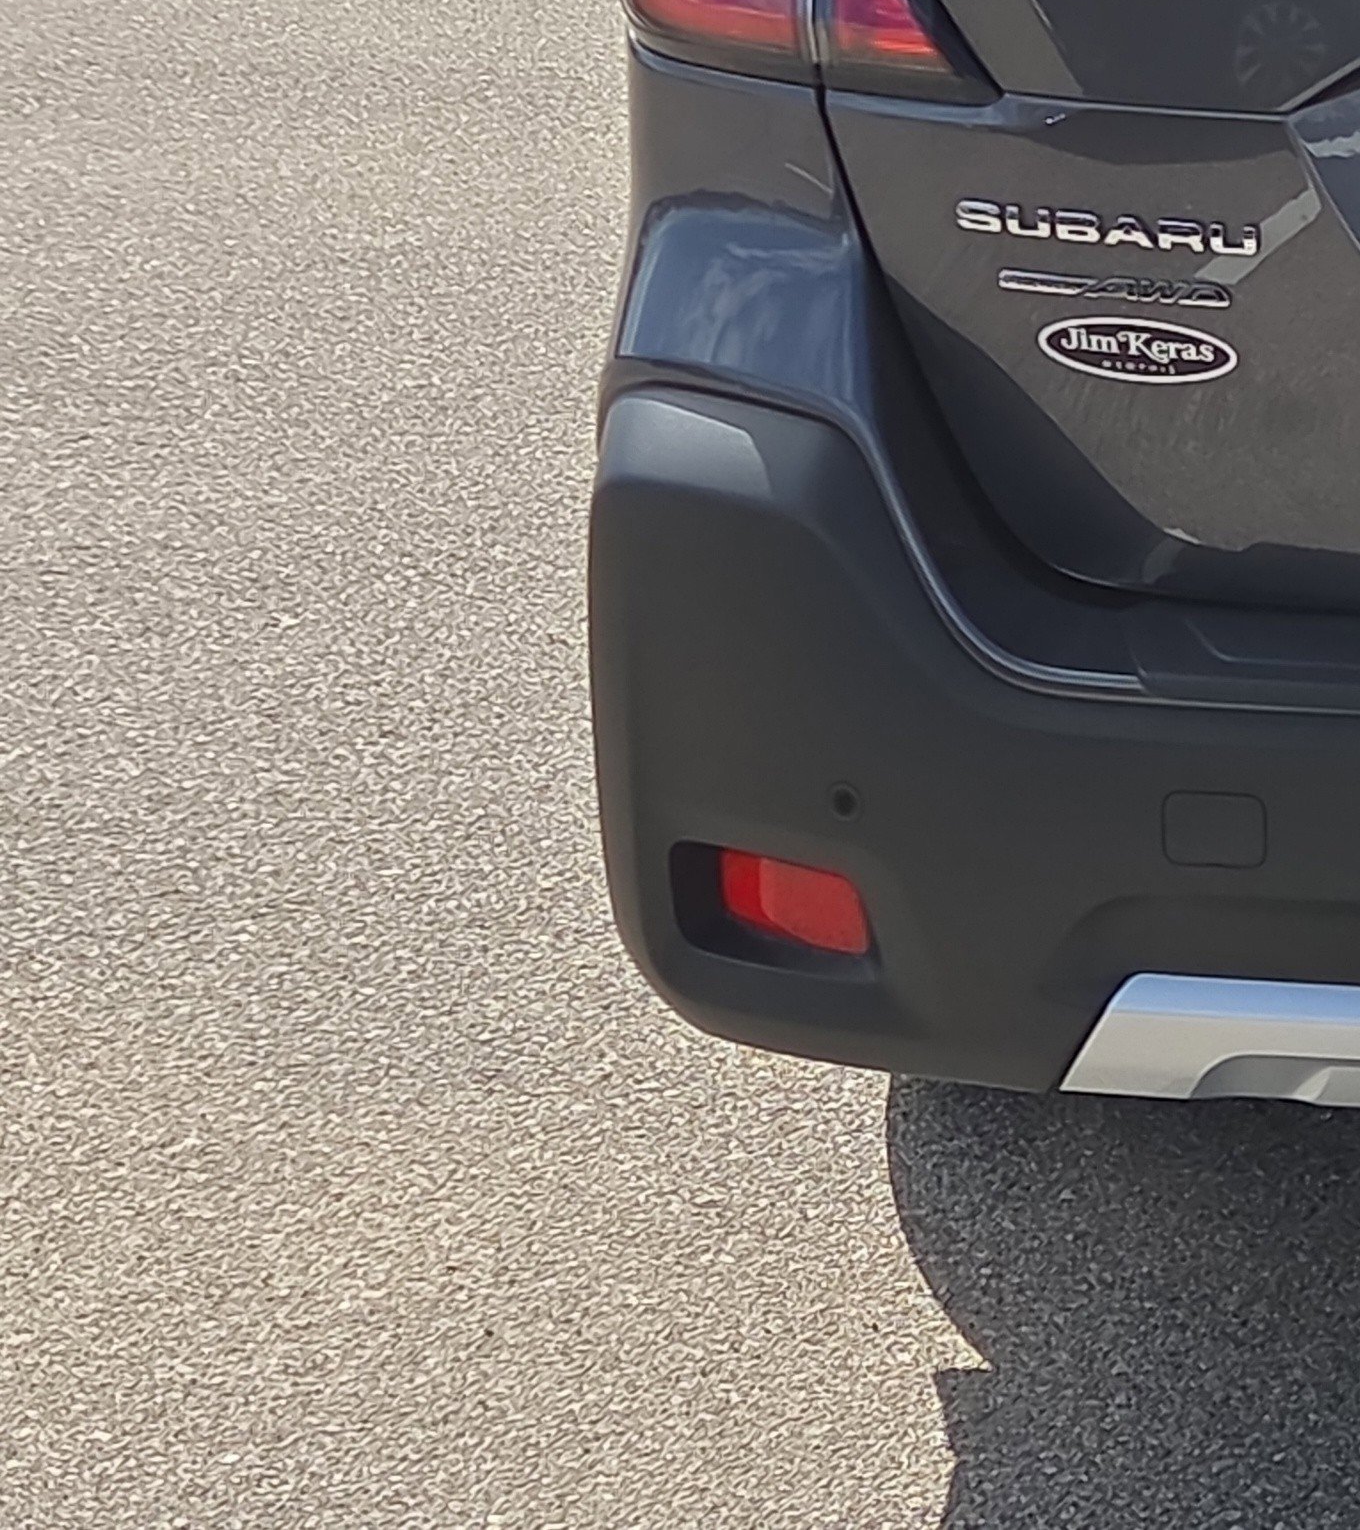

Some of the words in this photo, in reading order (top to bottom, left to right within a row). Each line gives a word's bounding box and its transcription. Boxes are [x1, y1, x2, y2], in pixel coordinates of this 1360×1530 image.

[954, 198, 1259, 257] SUBARU
[1060, 326, 1121, 355] Jim
[1115, 329, 1216, 365] Keras
